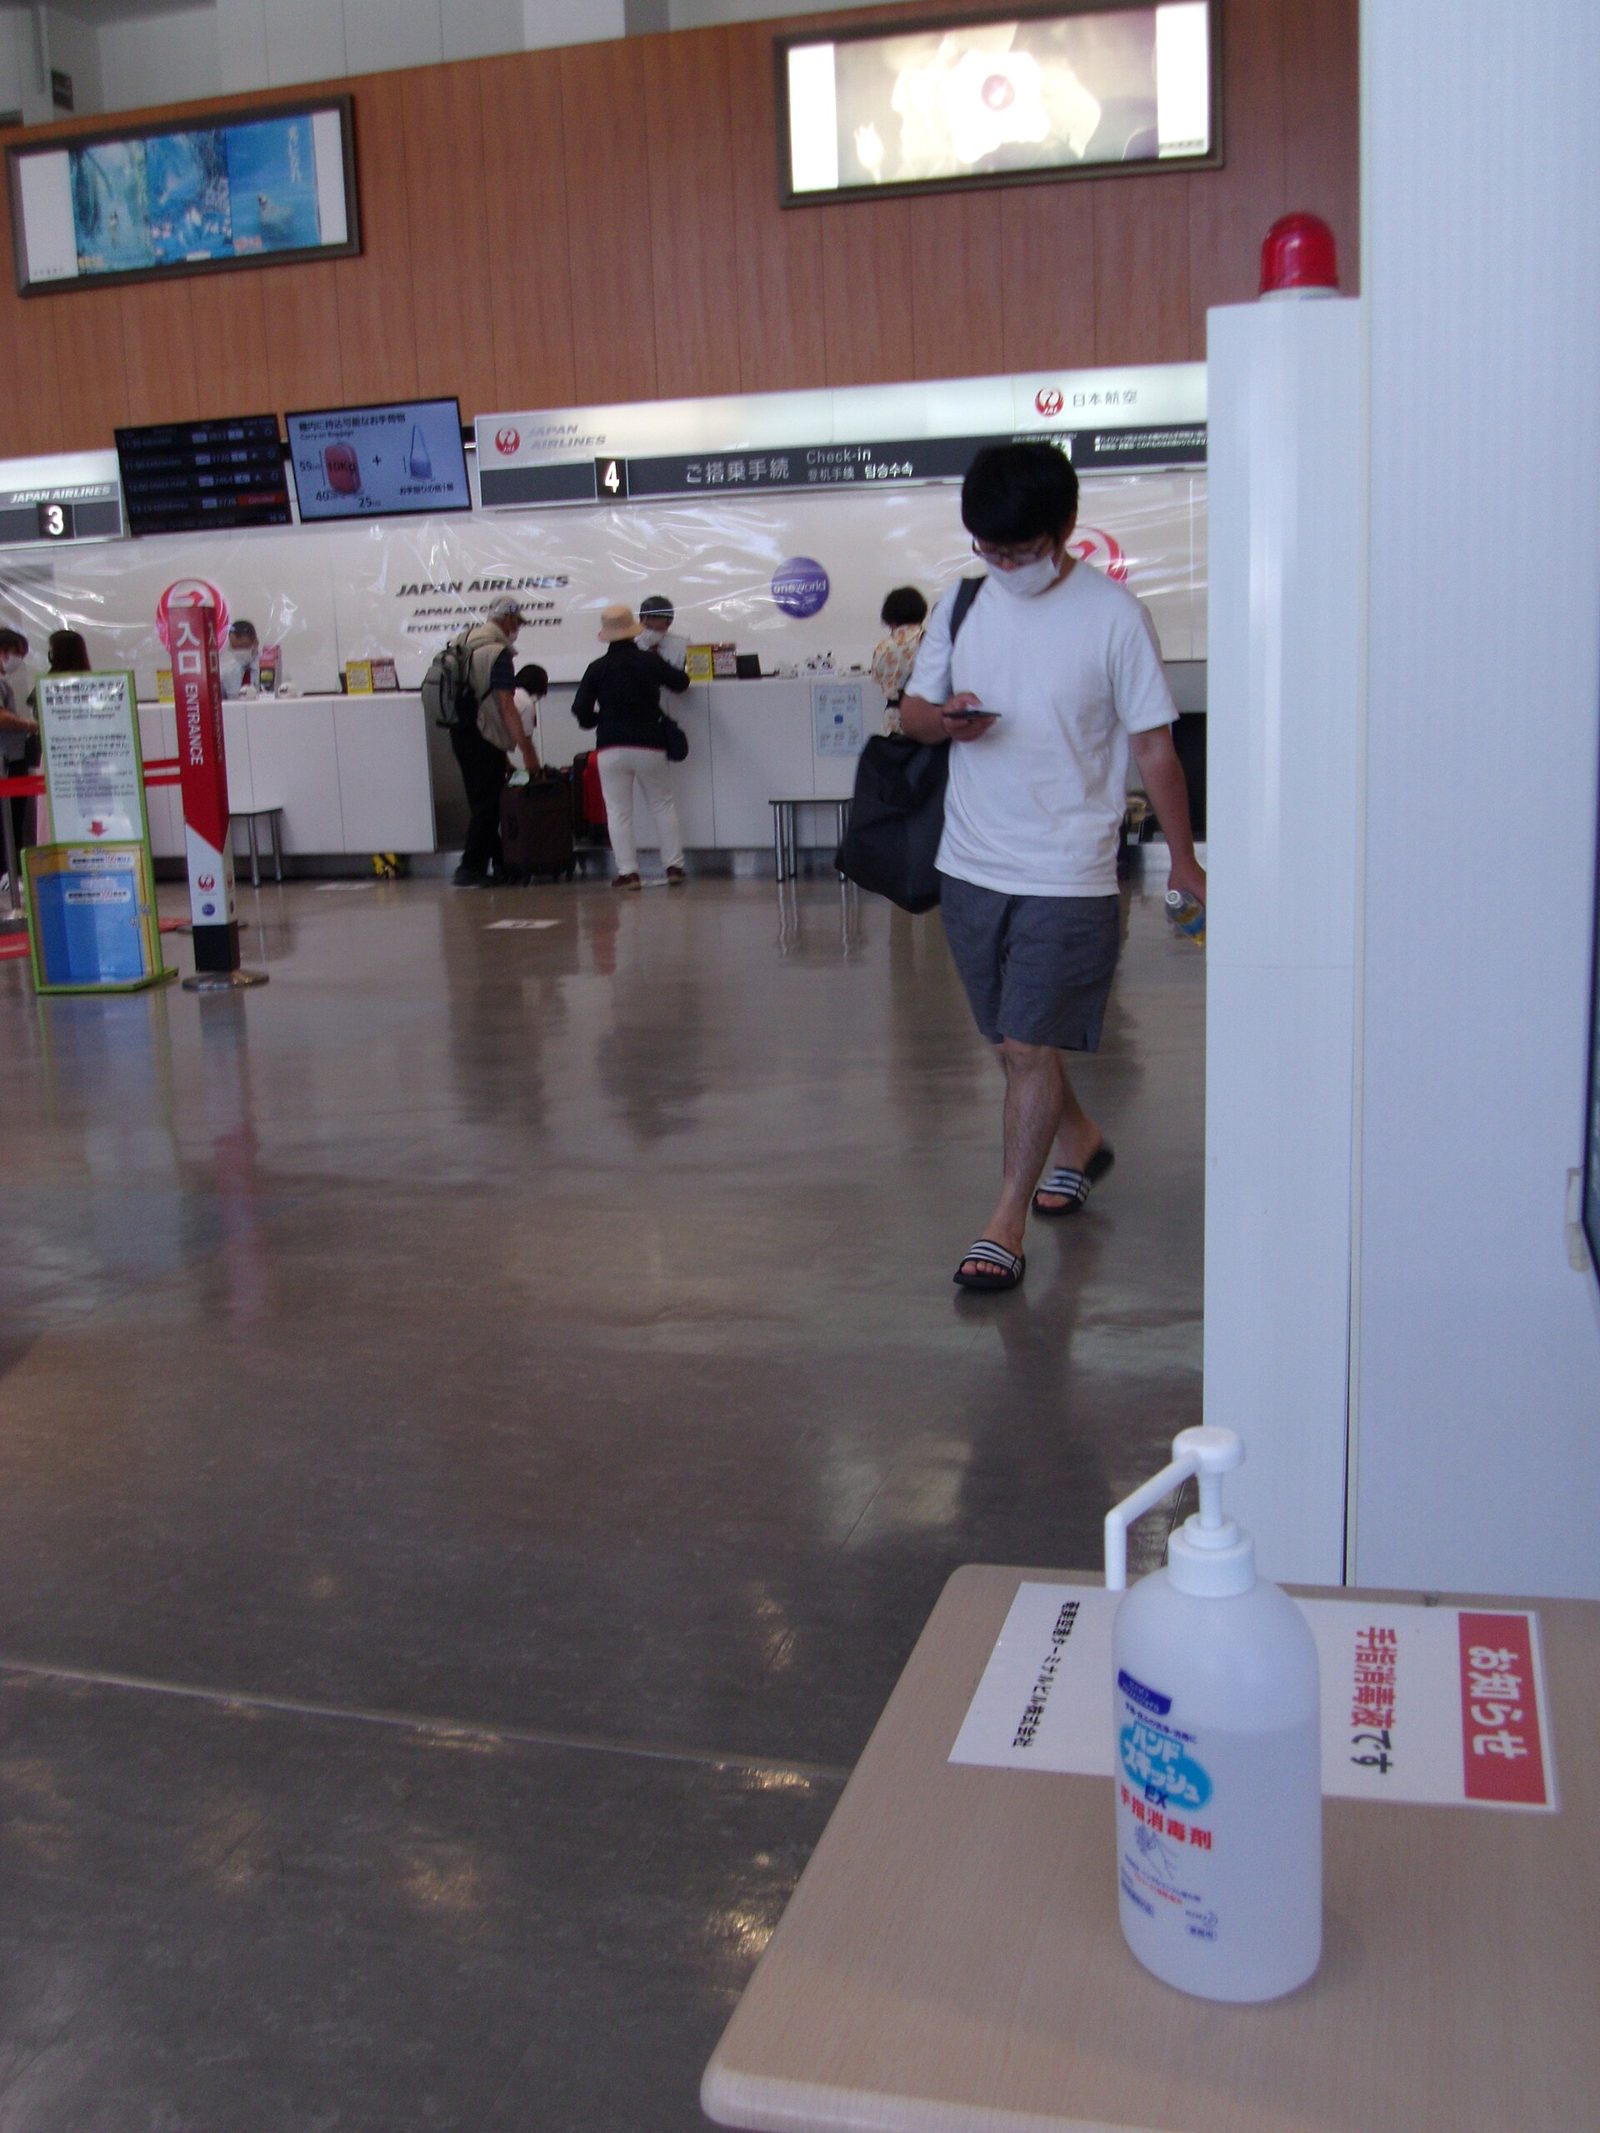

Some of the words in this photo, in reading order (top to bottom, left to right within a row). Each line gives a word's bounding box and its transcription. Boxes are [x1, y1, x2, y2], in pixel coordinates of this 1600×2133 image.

[1072, 390, 1138, 408] 日本航空
[530, 424, 578, 438] JAPAN
[531, 435, 607, 449] AIRLINES
[685, 456, 790, 485] ご搭乗手続
[806, 446, 872, 465] Check-in
[604, 460, 620, 494] 4
[10, 489, 50, 504] JAPAN
[52, 484, 112, 500] AIRLINES
[48, 504, 64, 535] 3
[396, 581, 463, 598] JAPAN
[467, 575, 570, 594] AIRLINES
[413, 607, 452, 617] JAPAN
[454, 605, 478, 615] AIR
[407, 622, 460, 633] RYUKYU
[176, 621, 202, 676] 入口
[208, 621, 220, 674] 入口
[184, 682, 204, 767] ENTRANCE
[1012, 1601, 1081, 1748] 奄美空港ターミナルビル株式会社
[1350, 1625, 1398, 1775] 手指消毒液です
[1467, 1645, 1528, 1760] お知らせ
[1132, 1721, 1182, 1763] ハンド
[1123, 1740, 1201, 1804] スキッシュ
[1144, 1783, 1169, 1810] EX
[1120, 1782, 1212, 1851] 手指消毒剤
